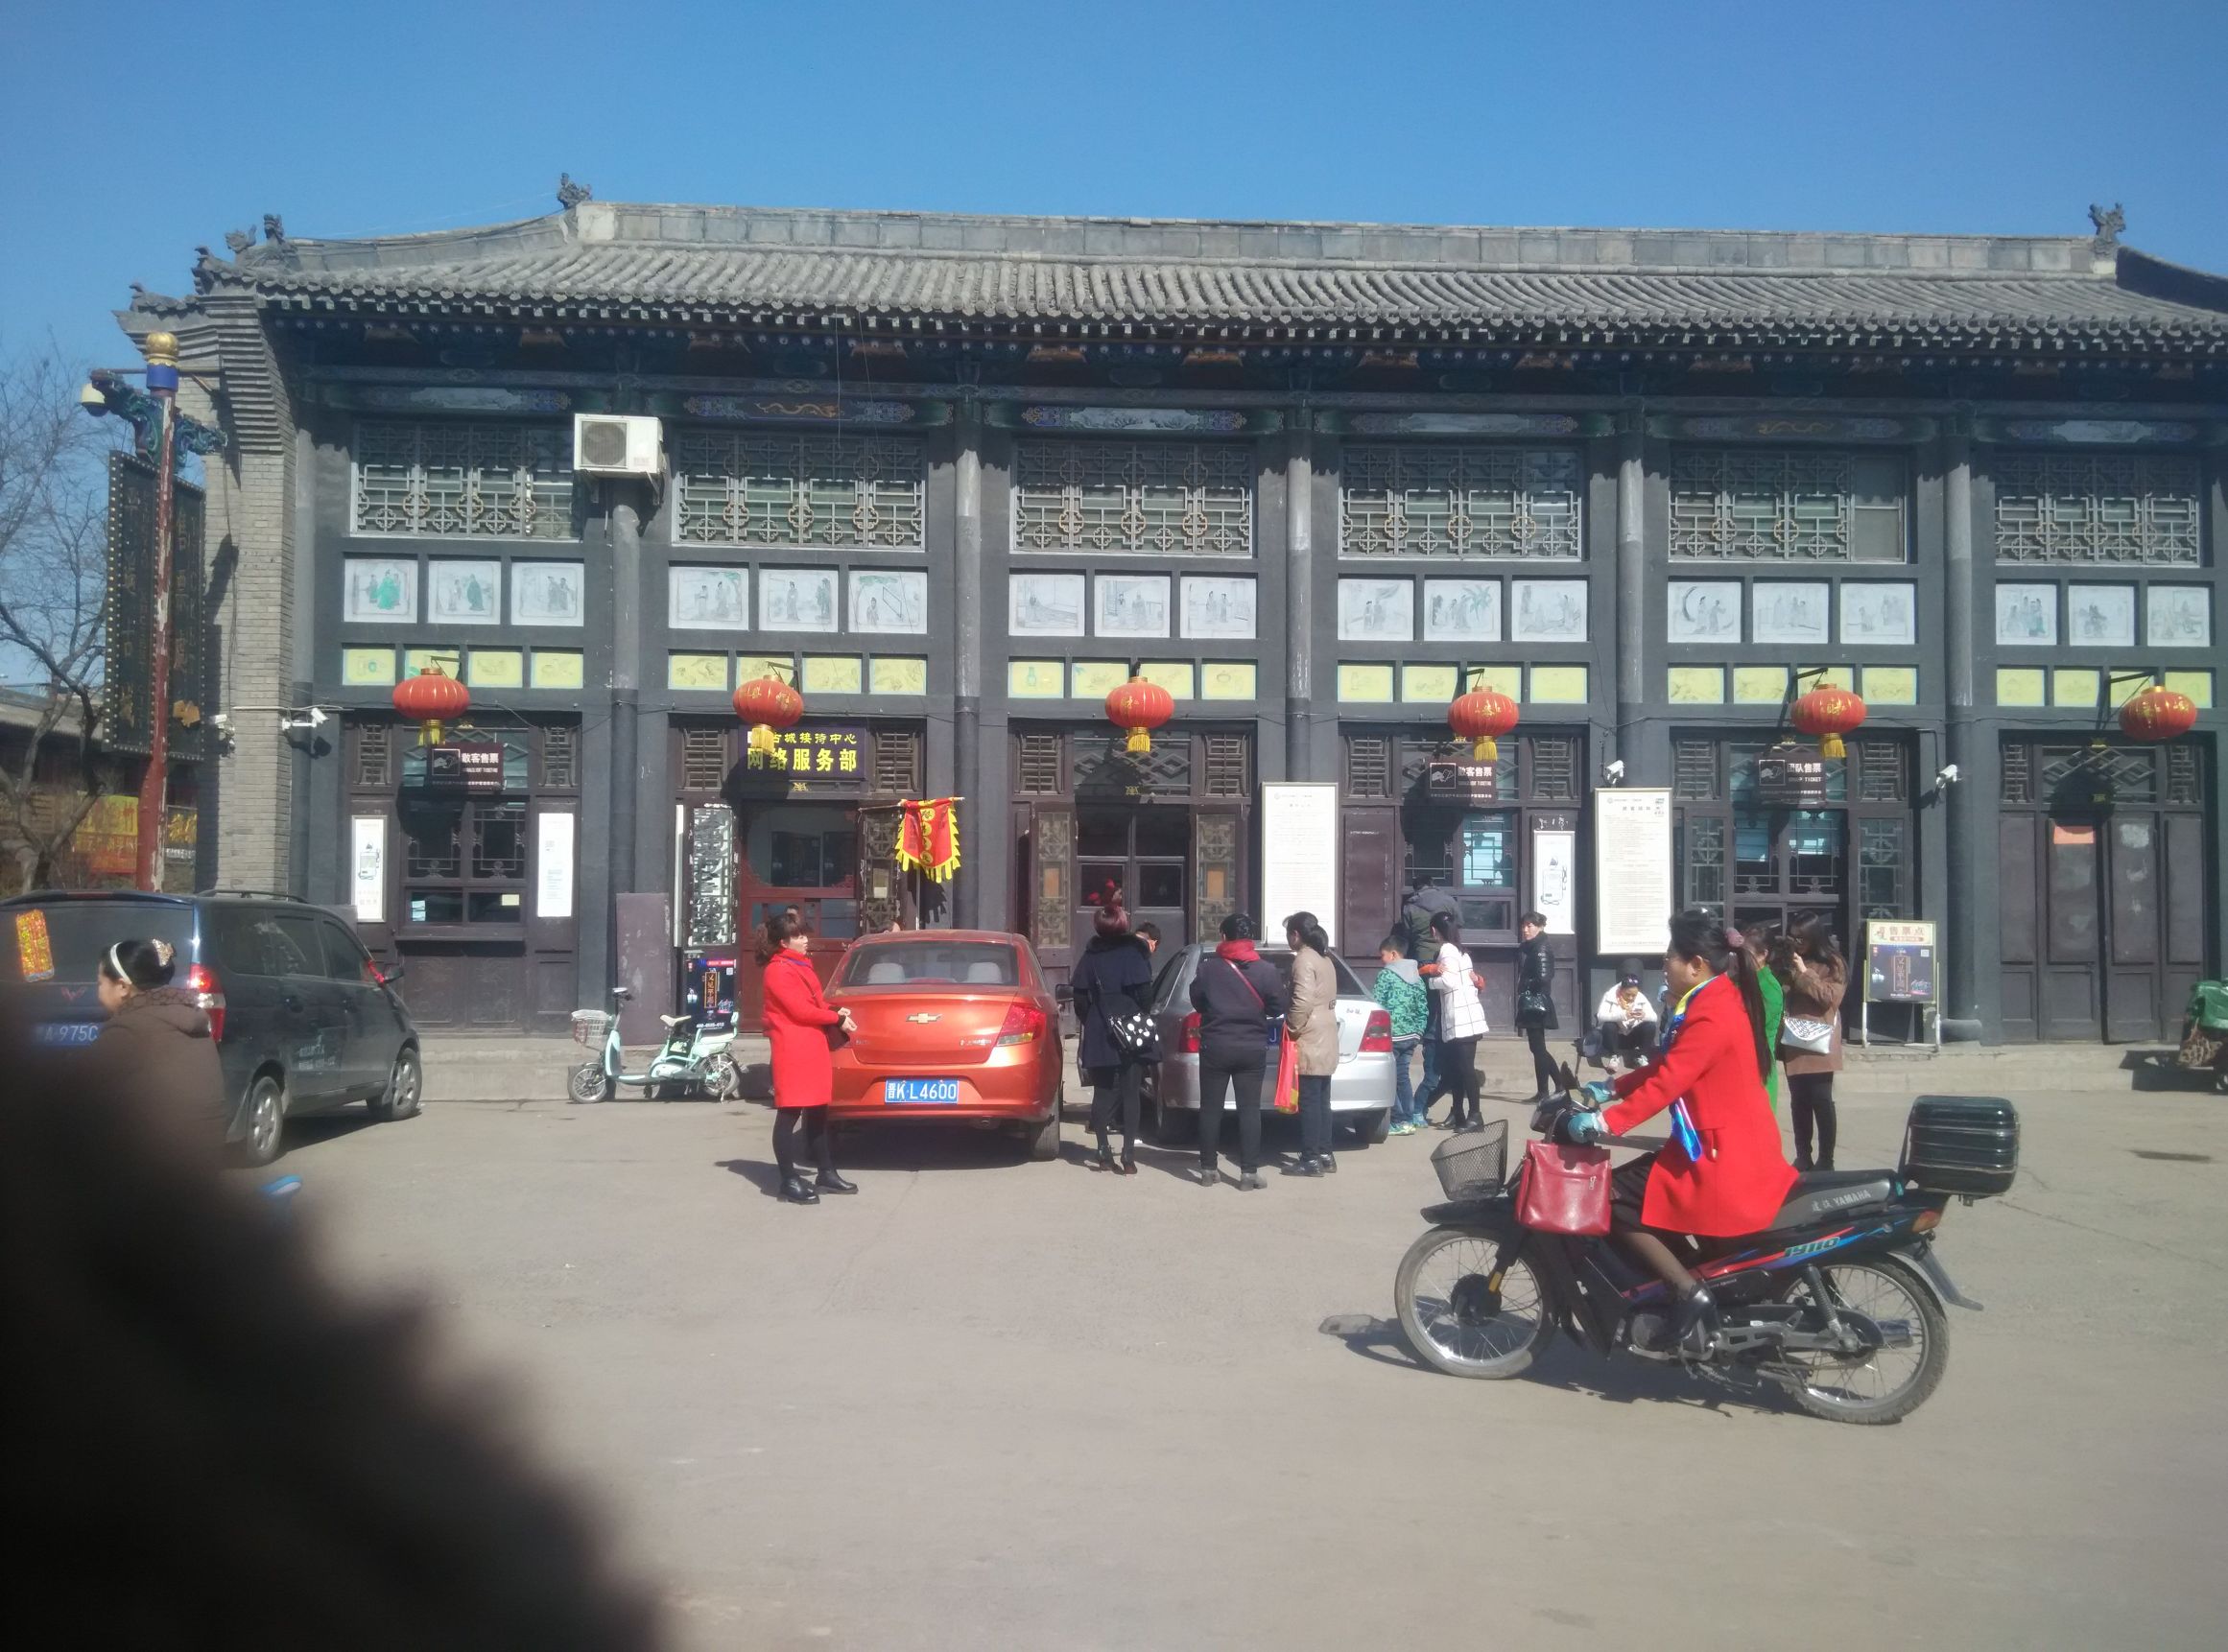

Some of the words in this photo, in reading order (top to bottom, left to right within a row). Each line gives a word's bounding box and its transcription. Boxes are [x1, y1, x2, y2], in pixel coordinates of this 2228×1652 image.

[462, 752, 499, 764] 散客售票
[747, 748, 857, 771] 网络服务部
[1833, 1189, 1871, 1207] YAMAHA
